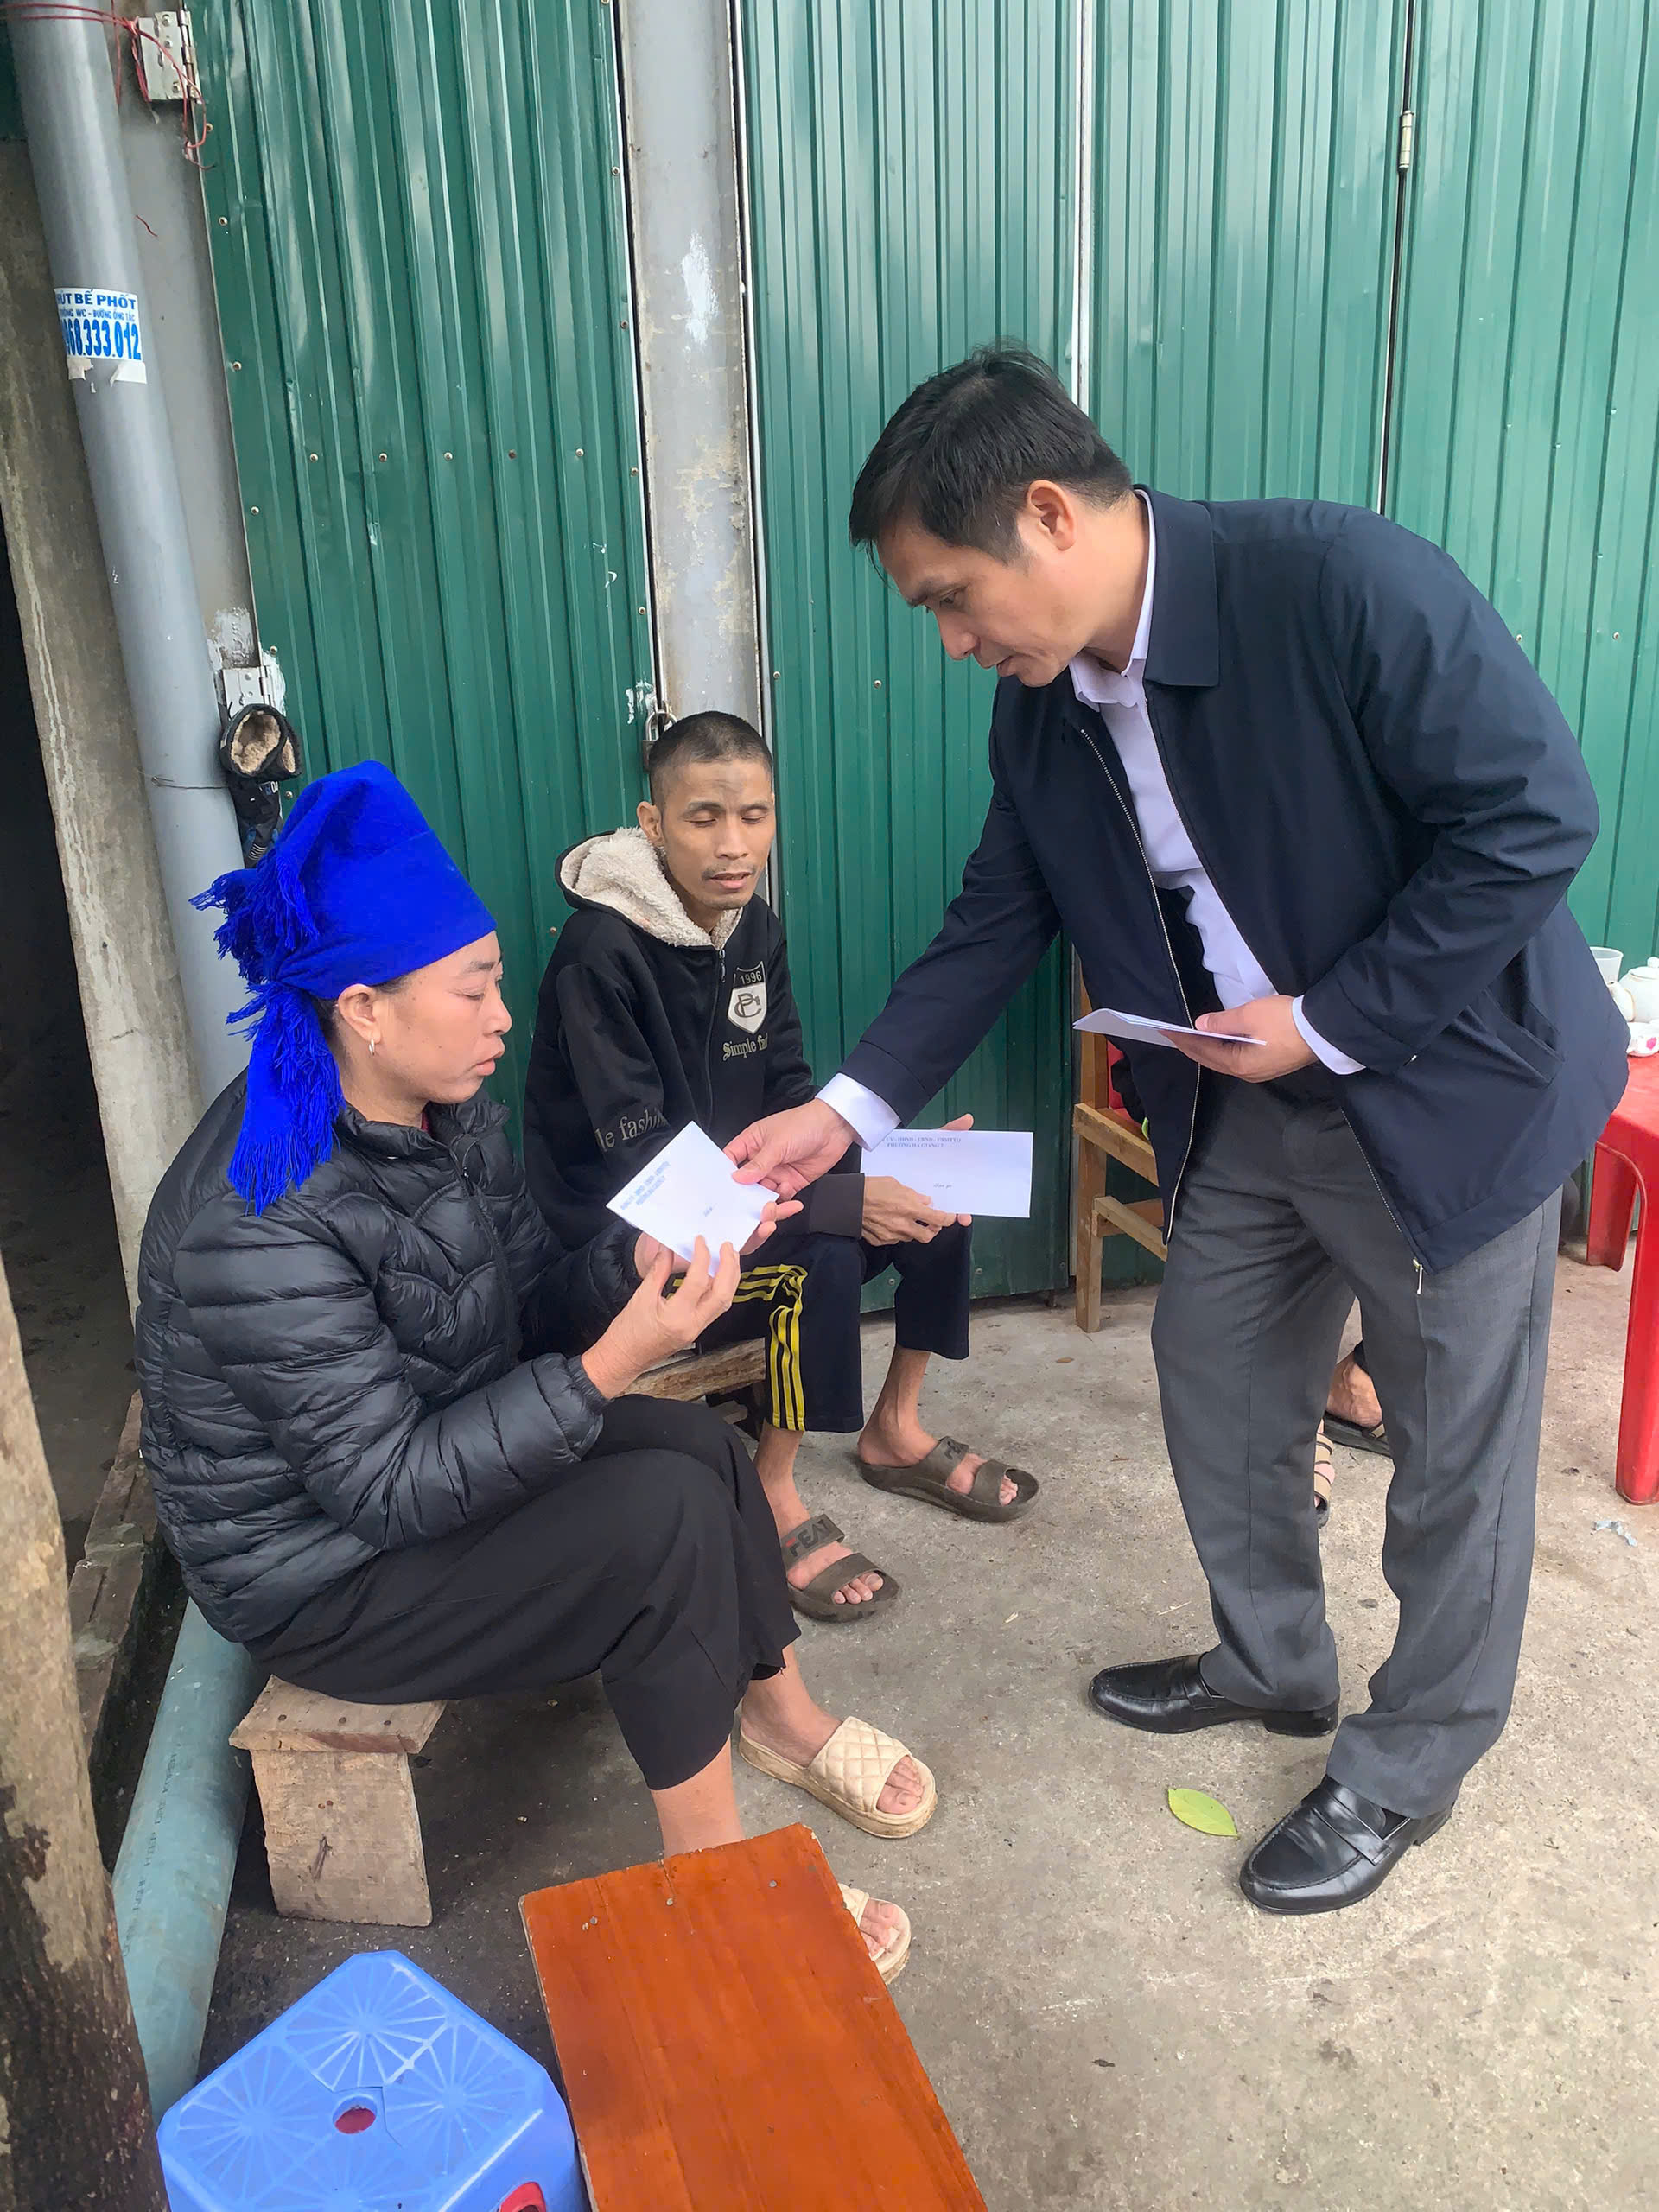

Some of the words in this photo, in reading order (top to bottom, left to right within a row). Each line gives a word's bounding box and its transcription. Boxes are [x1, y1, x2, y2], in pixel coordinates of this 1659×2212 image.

[97, 294, 137, 310] PHỐT
[76, 308, 87, 318] WC
[740, 970, 762, 985] 1996
[722, 1038, 757, 1061] Simple
